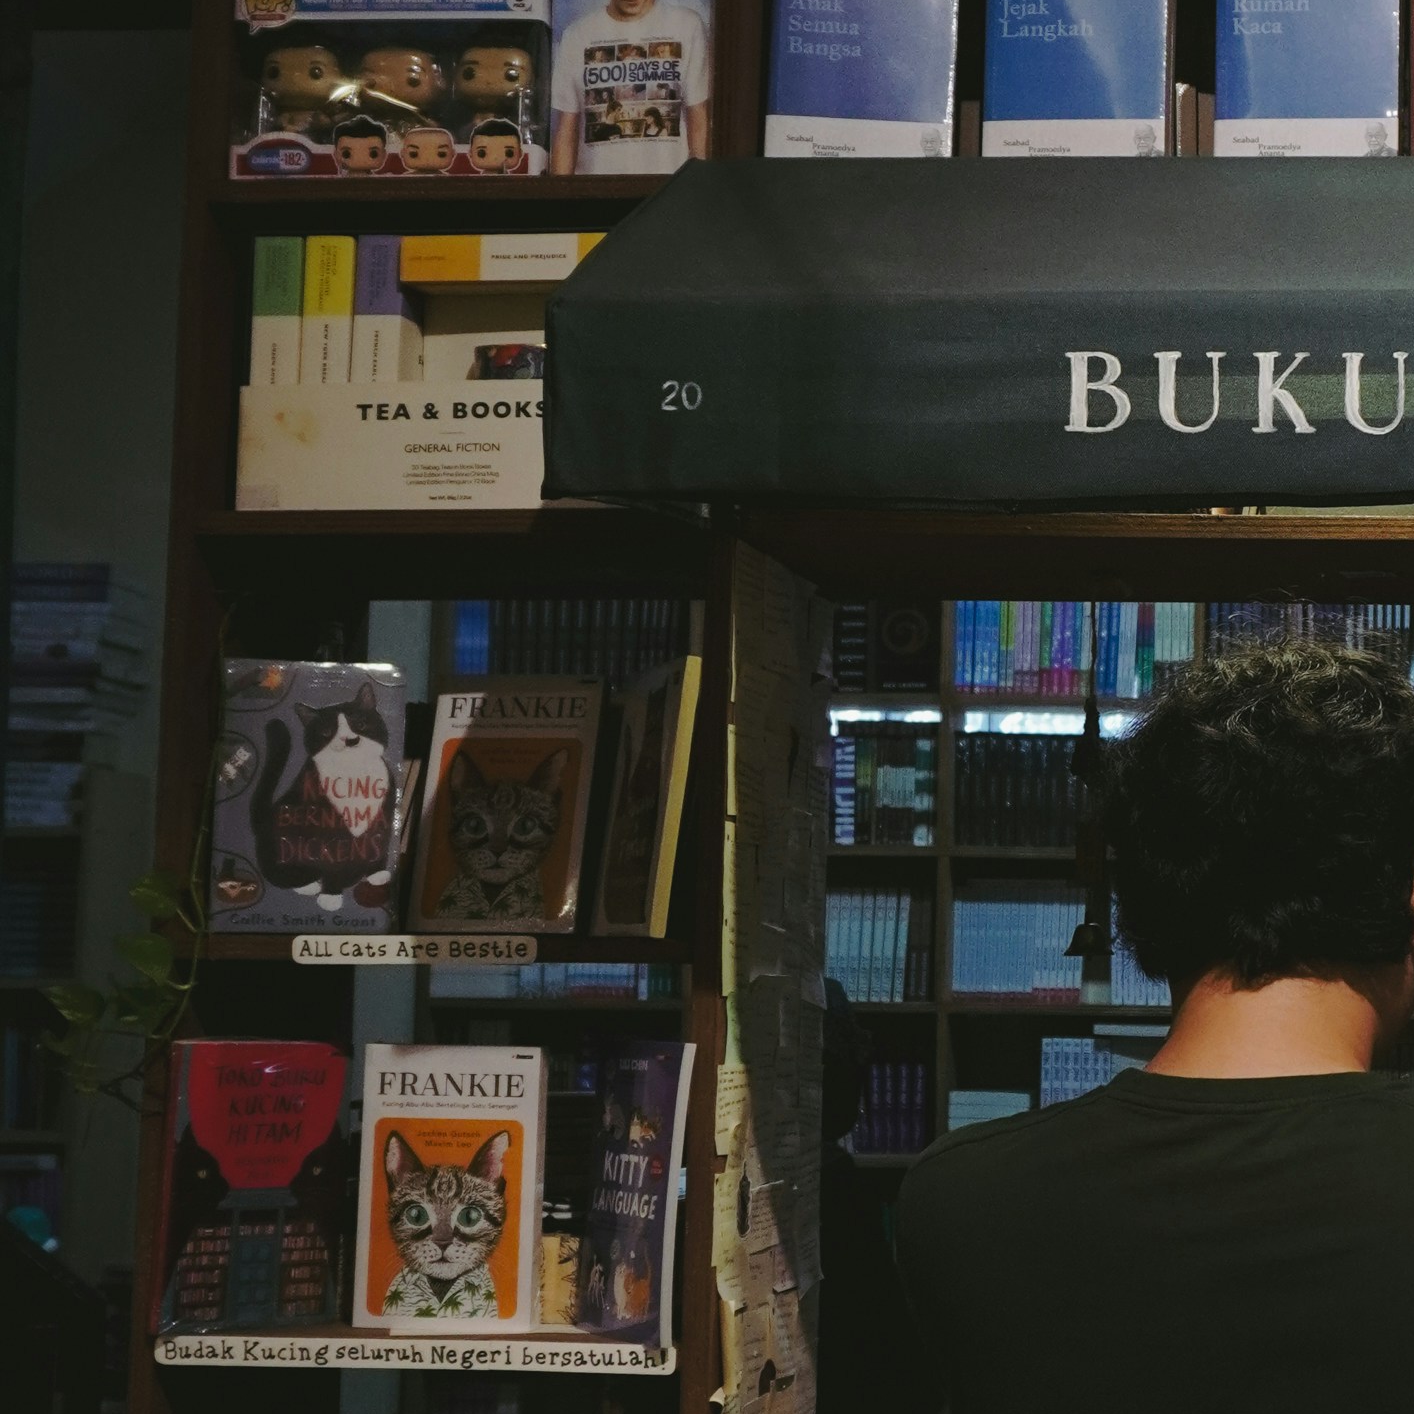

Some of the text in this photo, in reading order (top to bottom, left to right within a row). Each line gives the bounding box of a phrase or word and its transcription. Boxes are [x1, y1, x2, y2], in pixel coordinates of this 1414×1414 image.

[787, 15, 861, 39] Semua
[1000, 17, 1094, 42] Langkah
[1232, 16, 1283, 36] Kaca
[787, 35, 863, 60] Bangsa
[582, 60, 680, 86] (500) DAYS OF
[628, 68, 682, 84] SUMMER
[657, 377, 704, 414] 20
[356, 401, 441, 422] TEA &
[404, 442, 501, 454] GENERAL FICTION
[448, 693, 590, 722] FRANKIE
[276, 833, 384, 866] DICKENS
[229, 911, 377, 930] Callie Smith Grant
[339, 936, 529, 960] Cats Are Bestie
[215, 1064, 262, 1090] TOKO
[377, 1070, 526, 1099] FRANKIE
[227, 1090, 308, 1118] KUCING
[225, 1117, 303, 1147] HITAM
[602, 1149, 649, 1189] KITTY
[591, 1187, 659, 1221] LANGUAGE
[162, 1340, 670, 1371] Budak Kucing seluruh Negeri bersatulah!
